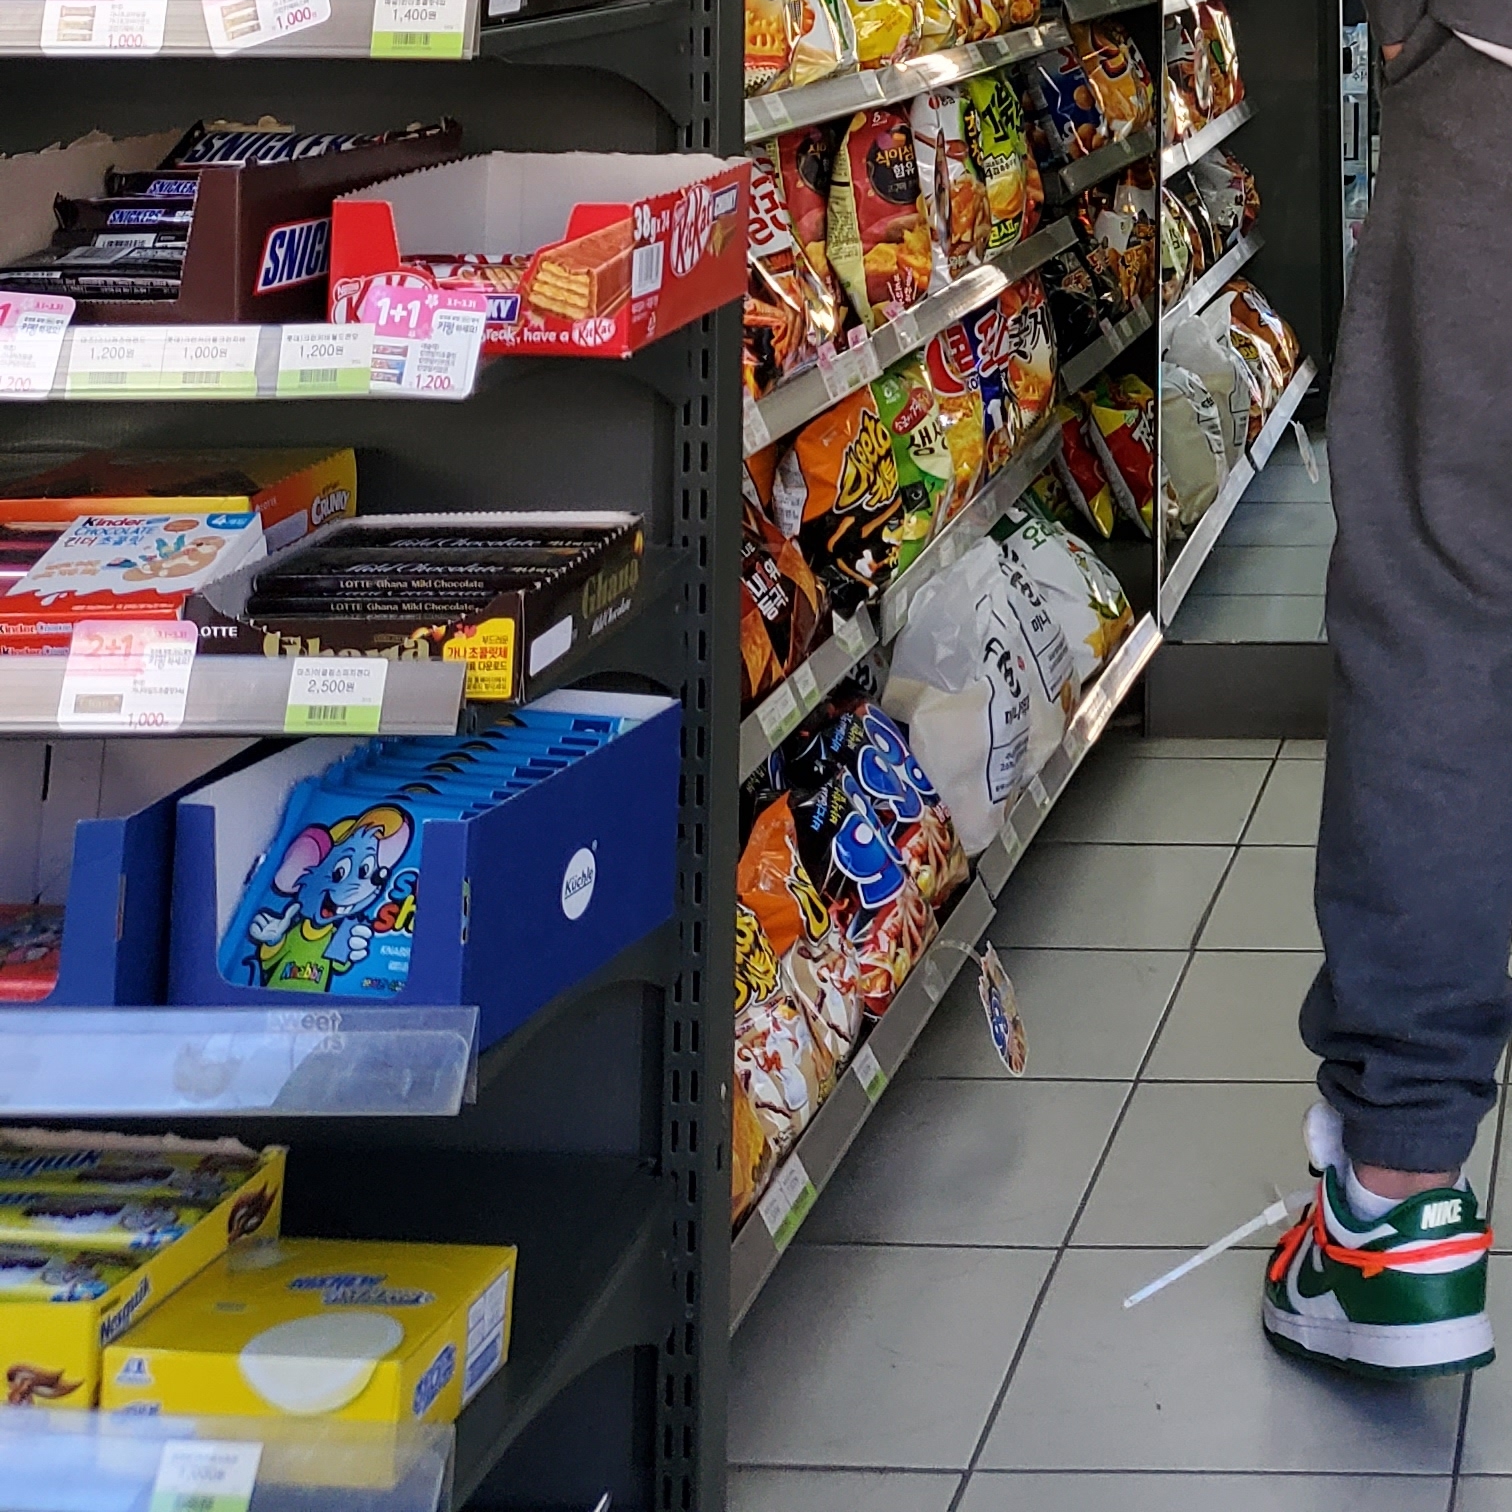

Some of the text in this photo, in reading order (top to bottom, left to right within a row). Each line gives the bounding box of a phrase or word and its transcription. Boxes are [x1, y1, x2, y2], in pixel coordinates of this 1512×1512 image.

[276, 7, 313, 31] 1,000
[391, 7, 438, 22] 1,400원
[106, 208, 166, 225] SNICKERS
[377, 297, 420, 330] 1+1
[523, 327, 557, 344] have
[89, 345, 135, 360] 1,200원
[182, 345, 229, 359] 1,000원
[299, 343, 345, 358] 1,200원
[415, 375, 452, 390] 1,200
[311, 488, 350, 526] CRUNKY
[306, 679, 356, 694] 2,500원
[562, 866, 596, 901] Küchle
[1420, 1198, 1463, 1231] NIKE
[100, 1274, 152, 1342] Nesquik
